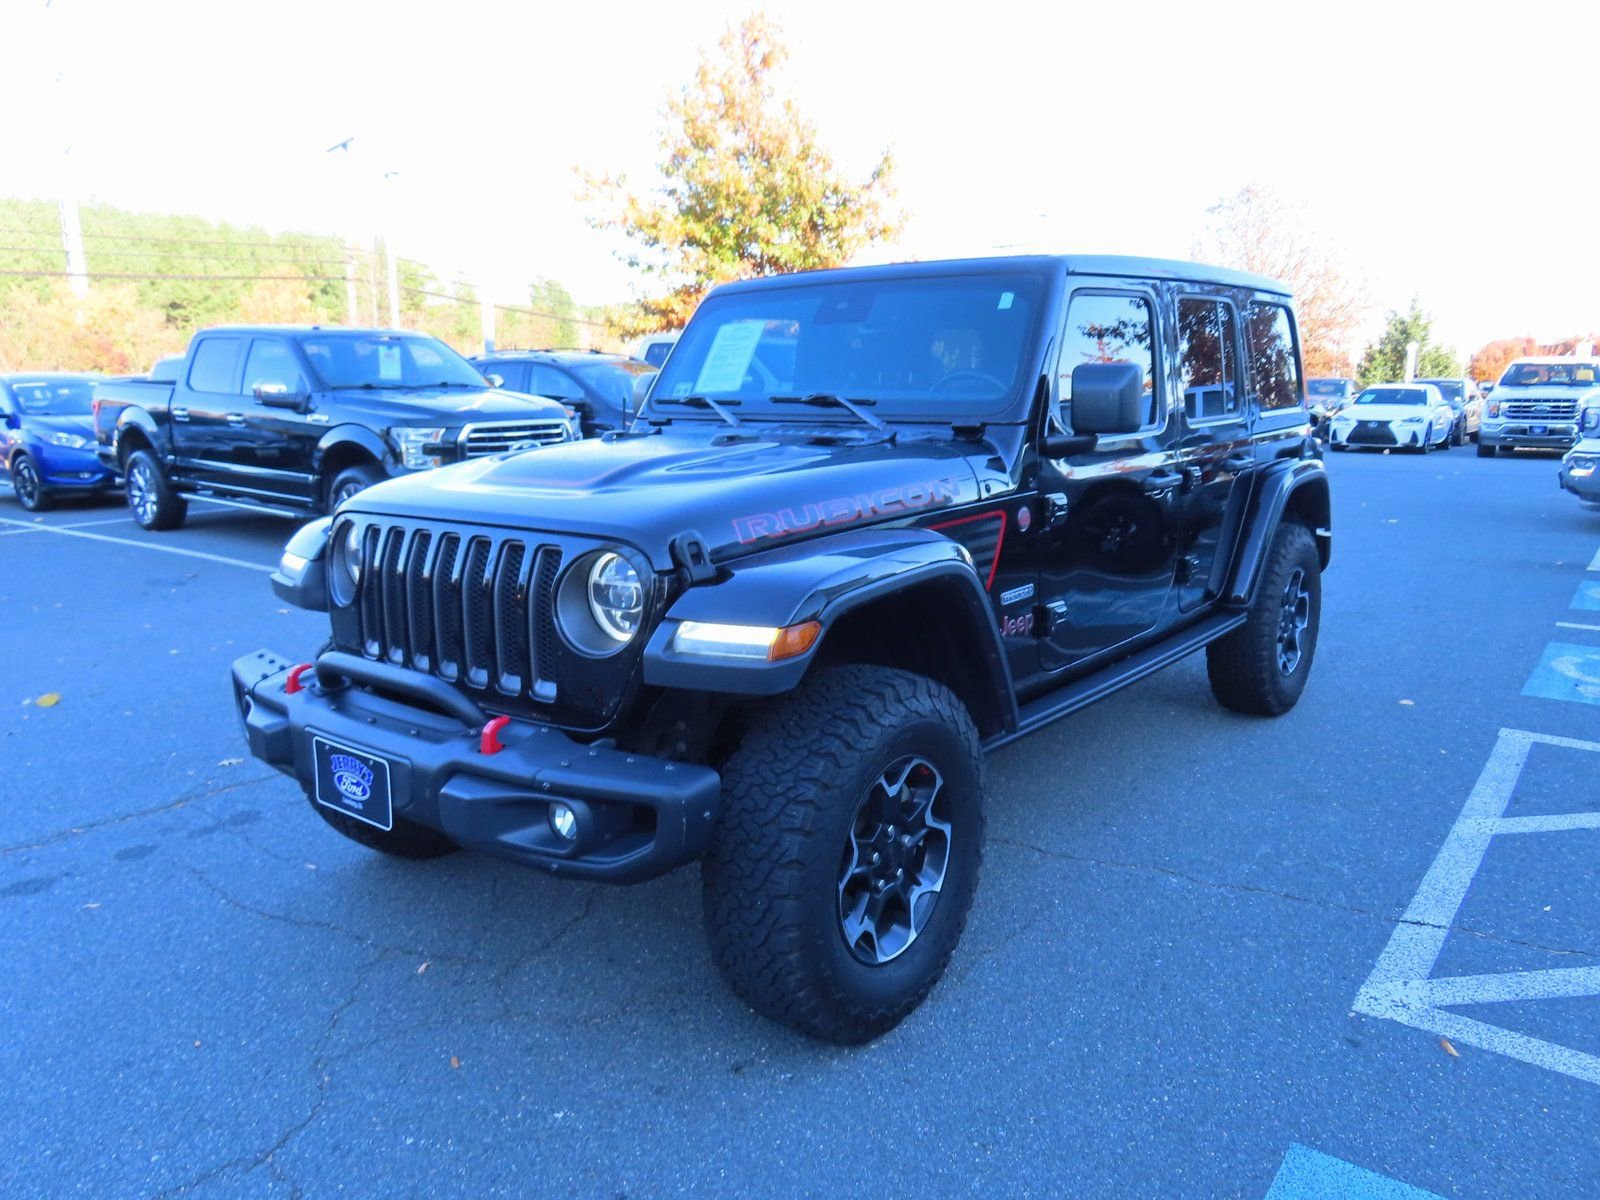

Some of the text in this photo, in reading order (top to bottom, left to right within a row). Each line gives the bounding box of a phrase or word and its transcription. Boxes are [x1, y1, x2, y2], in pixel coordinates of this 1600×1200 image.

[732, 476, 964, 544] RUBICON
[1000, 613, 1034, 637] Jeep
[341, 774, 364, 797] Ford
